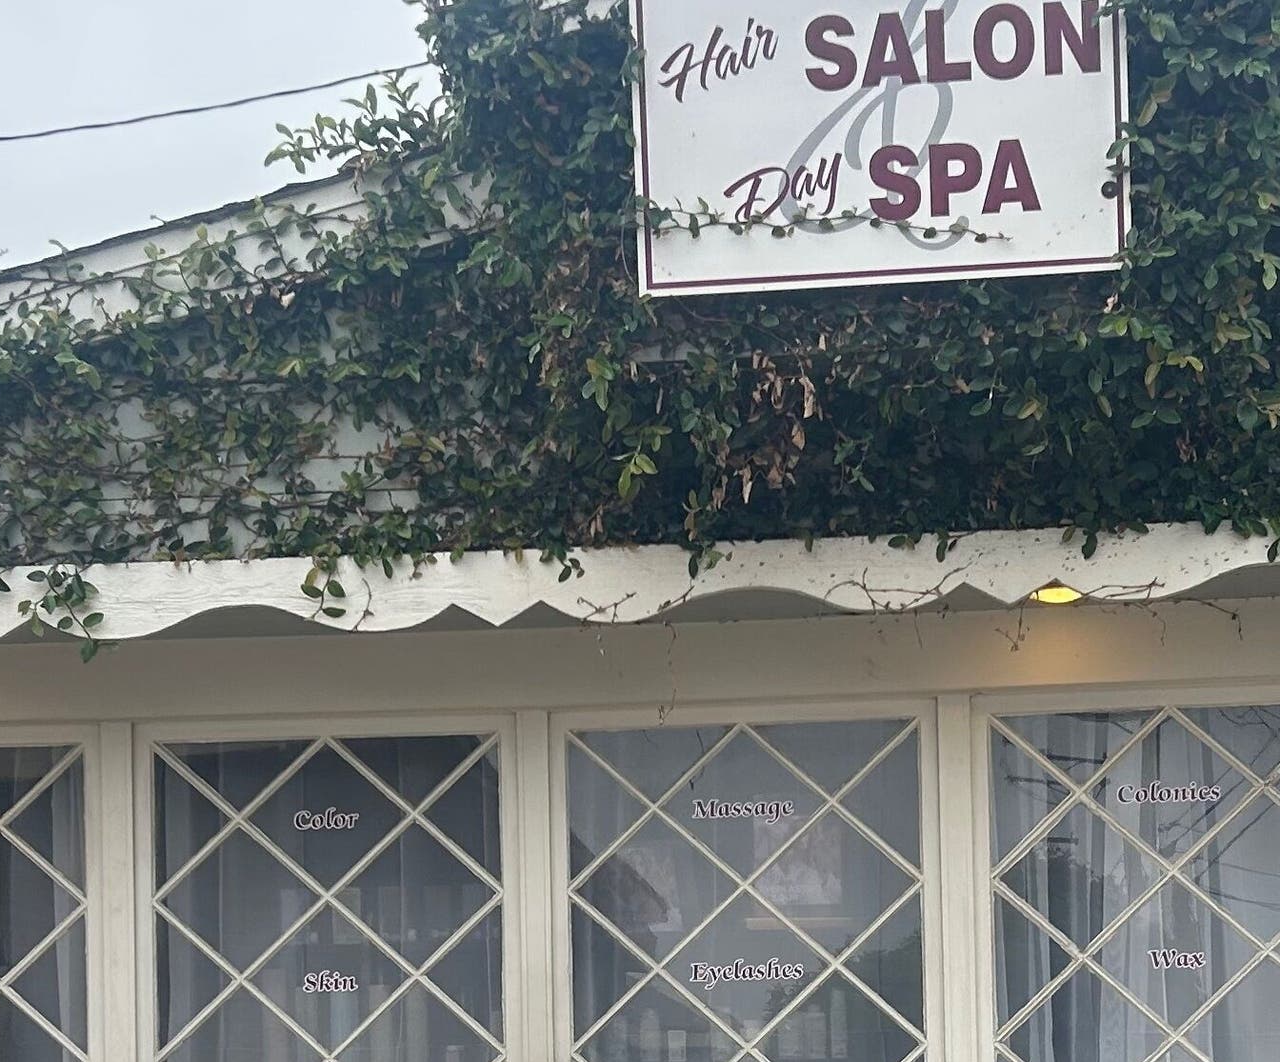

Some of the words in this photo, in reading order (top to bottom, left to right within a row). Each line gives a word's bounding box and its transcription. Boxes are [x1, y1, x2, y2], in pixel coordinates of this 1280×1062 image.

[657, 16, 779, 102] Hair
[805, 1, 1102, 92] SALON
[723, 152, 842, 223] Day
[868, 138, 1042, 222] SPA
[1117, 781, 1221, 804] Colonics
[293, 806, 360, 831] Color
[692, 798, 795, 825] Massage
[1147, 949, 1206, 969] Wax
[302, 969, 359, 993] Skin
[689, 957, 804, 990] Eyelashes
